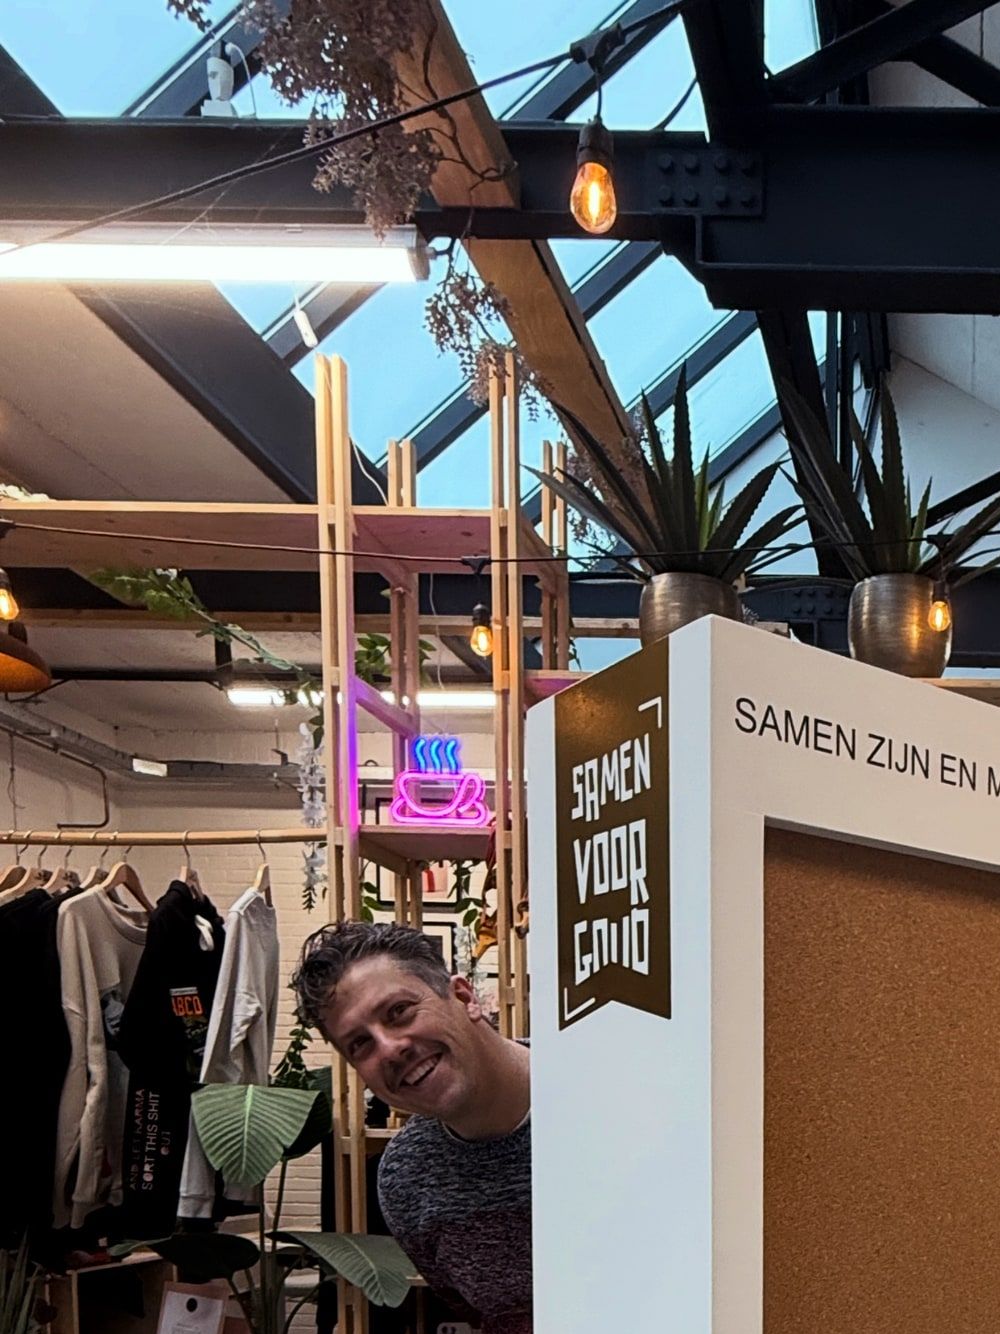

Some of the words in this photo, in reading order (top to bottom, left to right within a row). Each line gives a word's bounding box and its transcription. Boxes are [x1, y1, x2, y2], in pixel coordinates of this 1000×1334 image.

[734, 697, 857, 761] SAMEN
[866, 733, 930, 780] ZIJN
[940, 753, 977, 792] EN
[571, 732, 651, 822] SAMEN
[573, 818, 650, 905] VOOR
[134, 1088, 145, 1134] KARMA
[147, 1091, 161, 1121] SHIT
[145, 1124, 158, 1152] THIS
[141, 1155, 155, 1191] SORT
